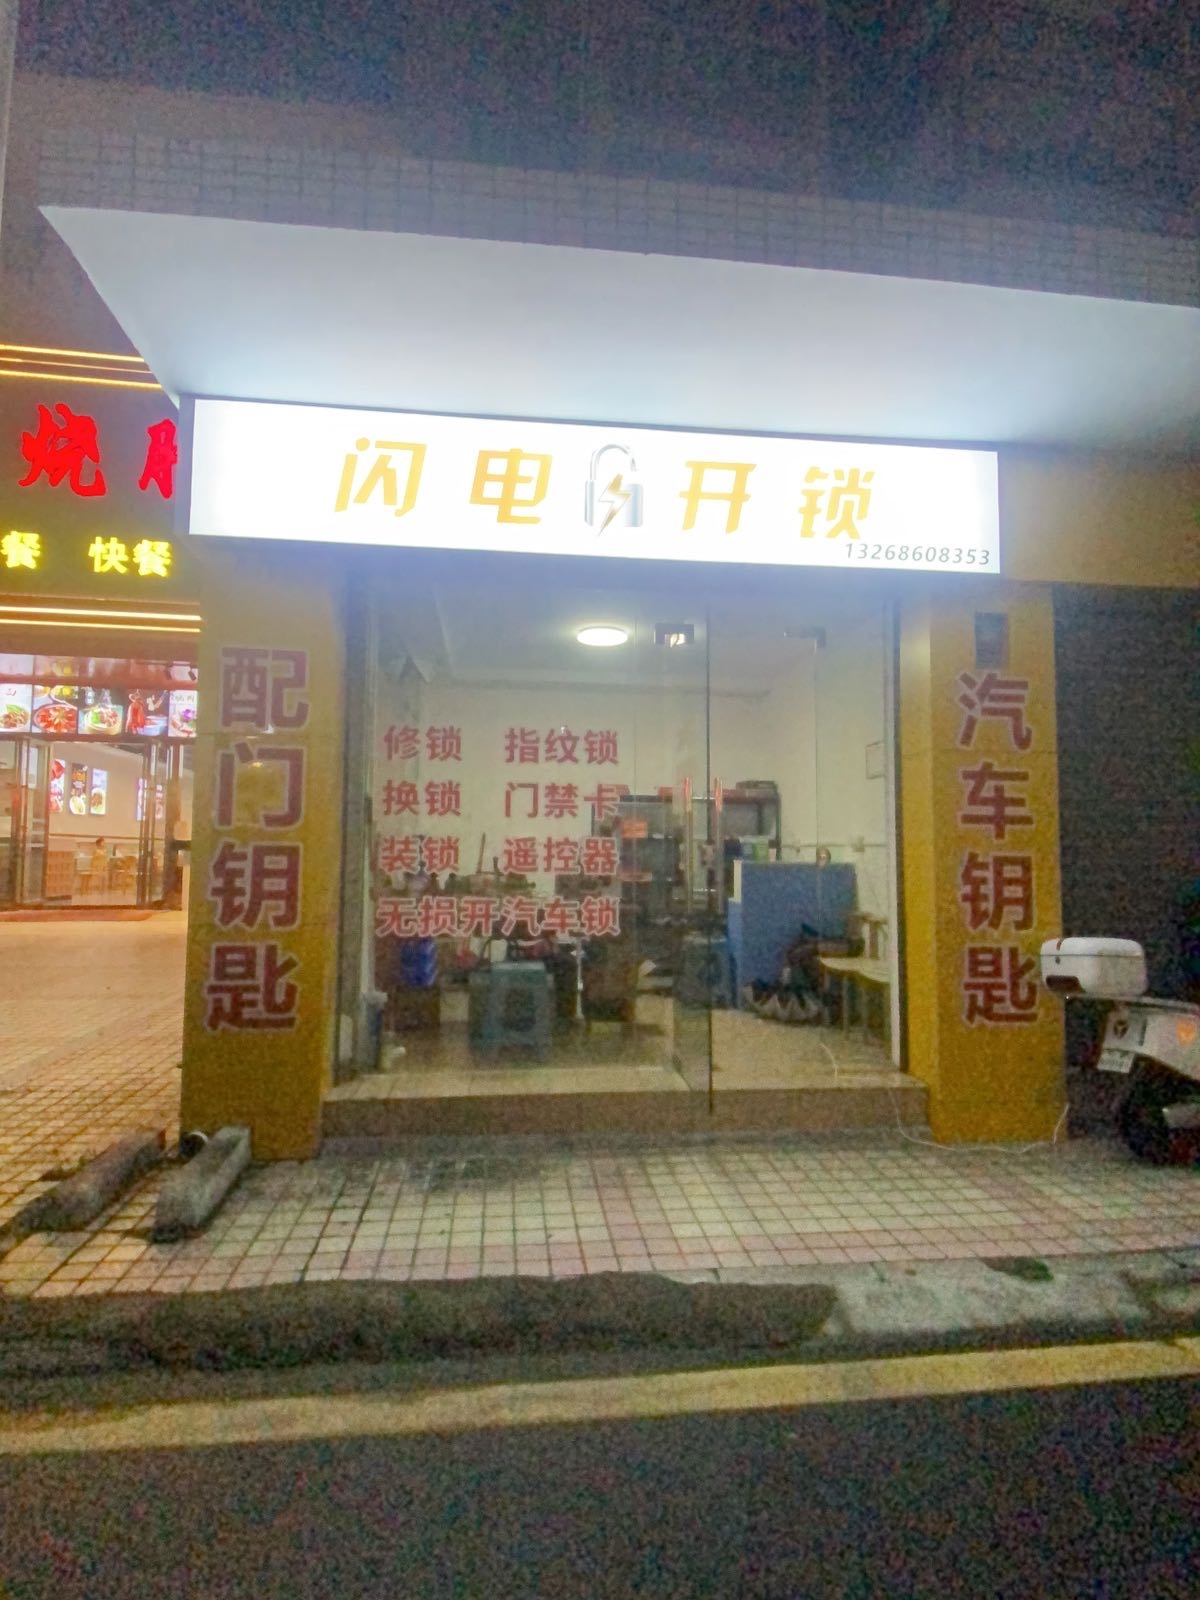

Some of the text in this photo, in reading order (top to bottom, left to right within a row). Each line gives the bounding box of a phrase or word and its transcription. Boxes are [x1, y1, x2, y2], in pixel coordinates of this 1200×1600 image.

[88, 536, 172, 577] 快餐
[845, 543, 990, 566] 13268608353
[383, 725, 462, 762] 修锁
[504, 727, 619, 765] 指纹锁
[382, 780, 461, 817] 换锁
[504, 782, 619, 819] 门禁卡
[205, 645, 310, 1032] 配门钥匙
[379, 836, 461, 874] 装锁
[503, 836, 620, 876] 遥控器
[958, 671, 1039, 1026] 汽车钥匙
[375, 896, 622, 937] 无损开汽车锁
